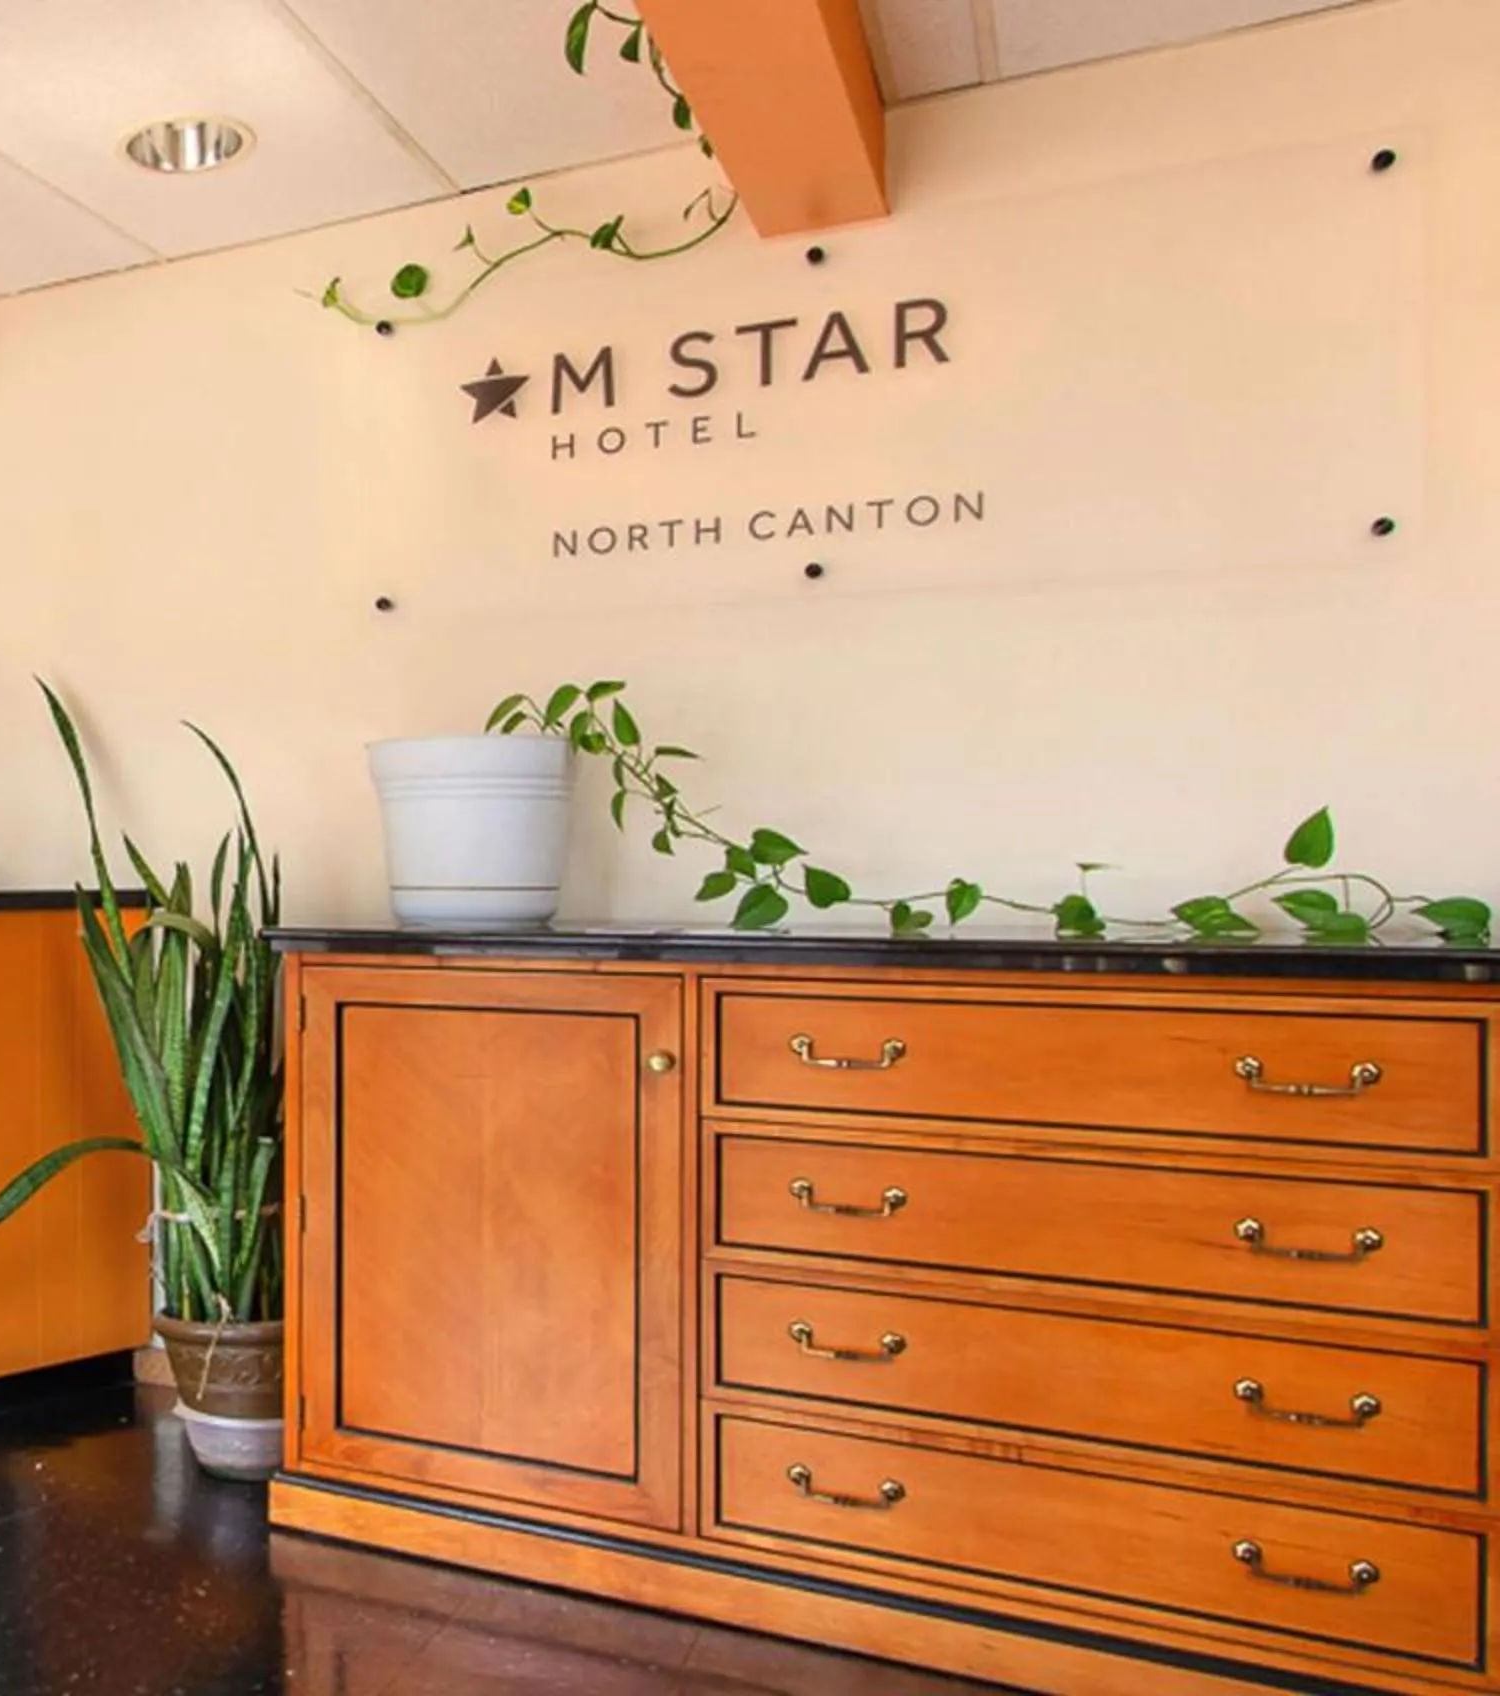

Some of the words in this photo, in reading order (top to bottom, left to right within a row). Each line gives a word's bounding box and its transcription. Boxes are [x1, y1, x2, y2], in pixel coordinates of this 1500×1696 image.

[551, 346, 616, 415] M
[668, 298, 951, 398] STAR
[551, 411, 757, 460] HOTEL
[553, 517, 722, 558] NORTH
[748, 491, 985, 541] CANTON
